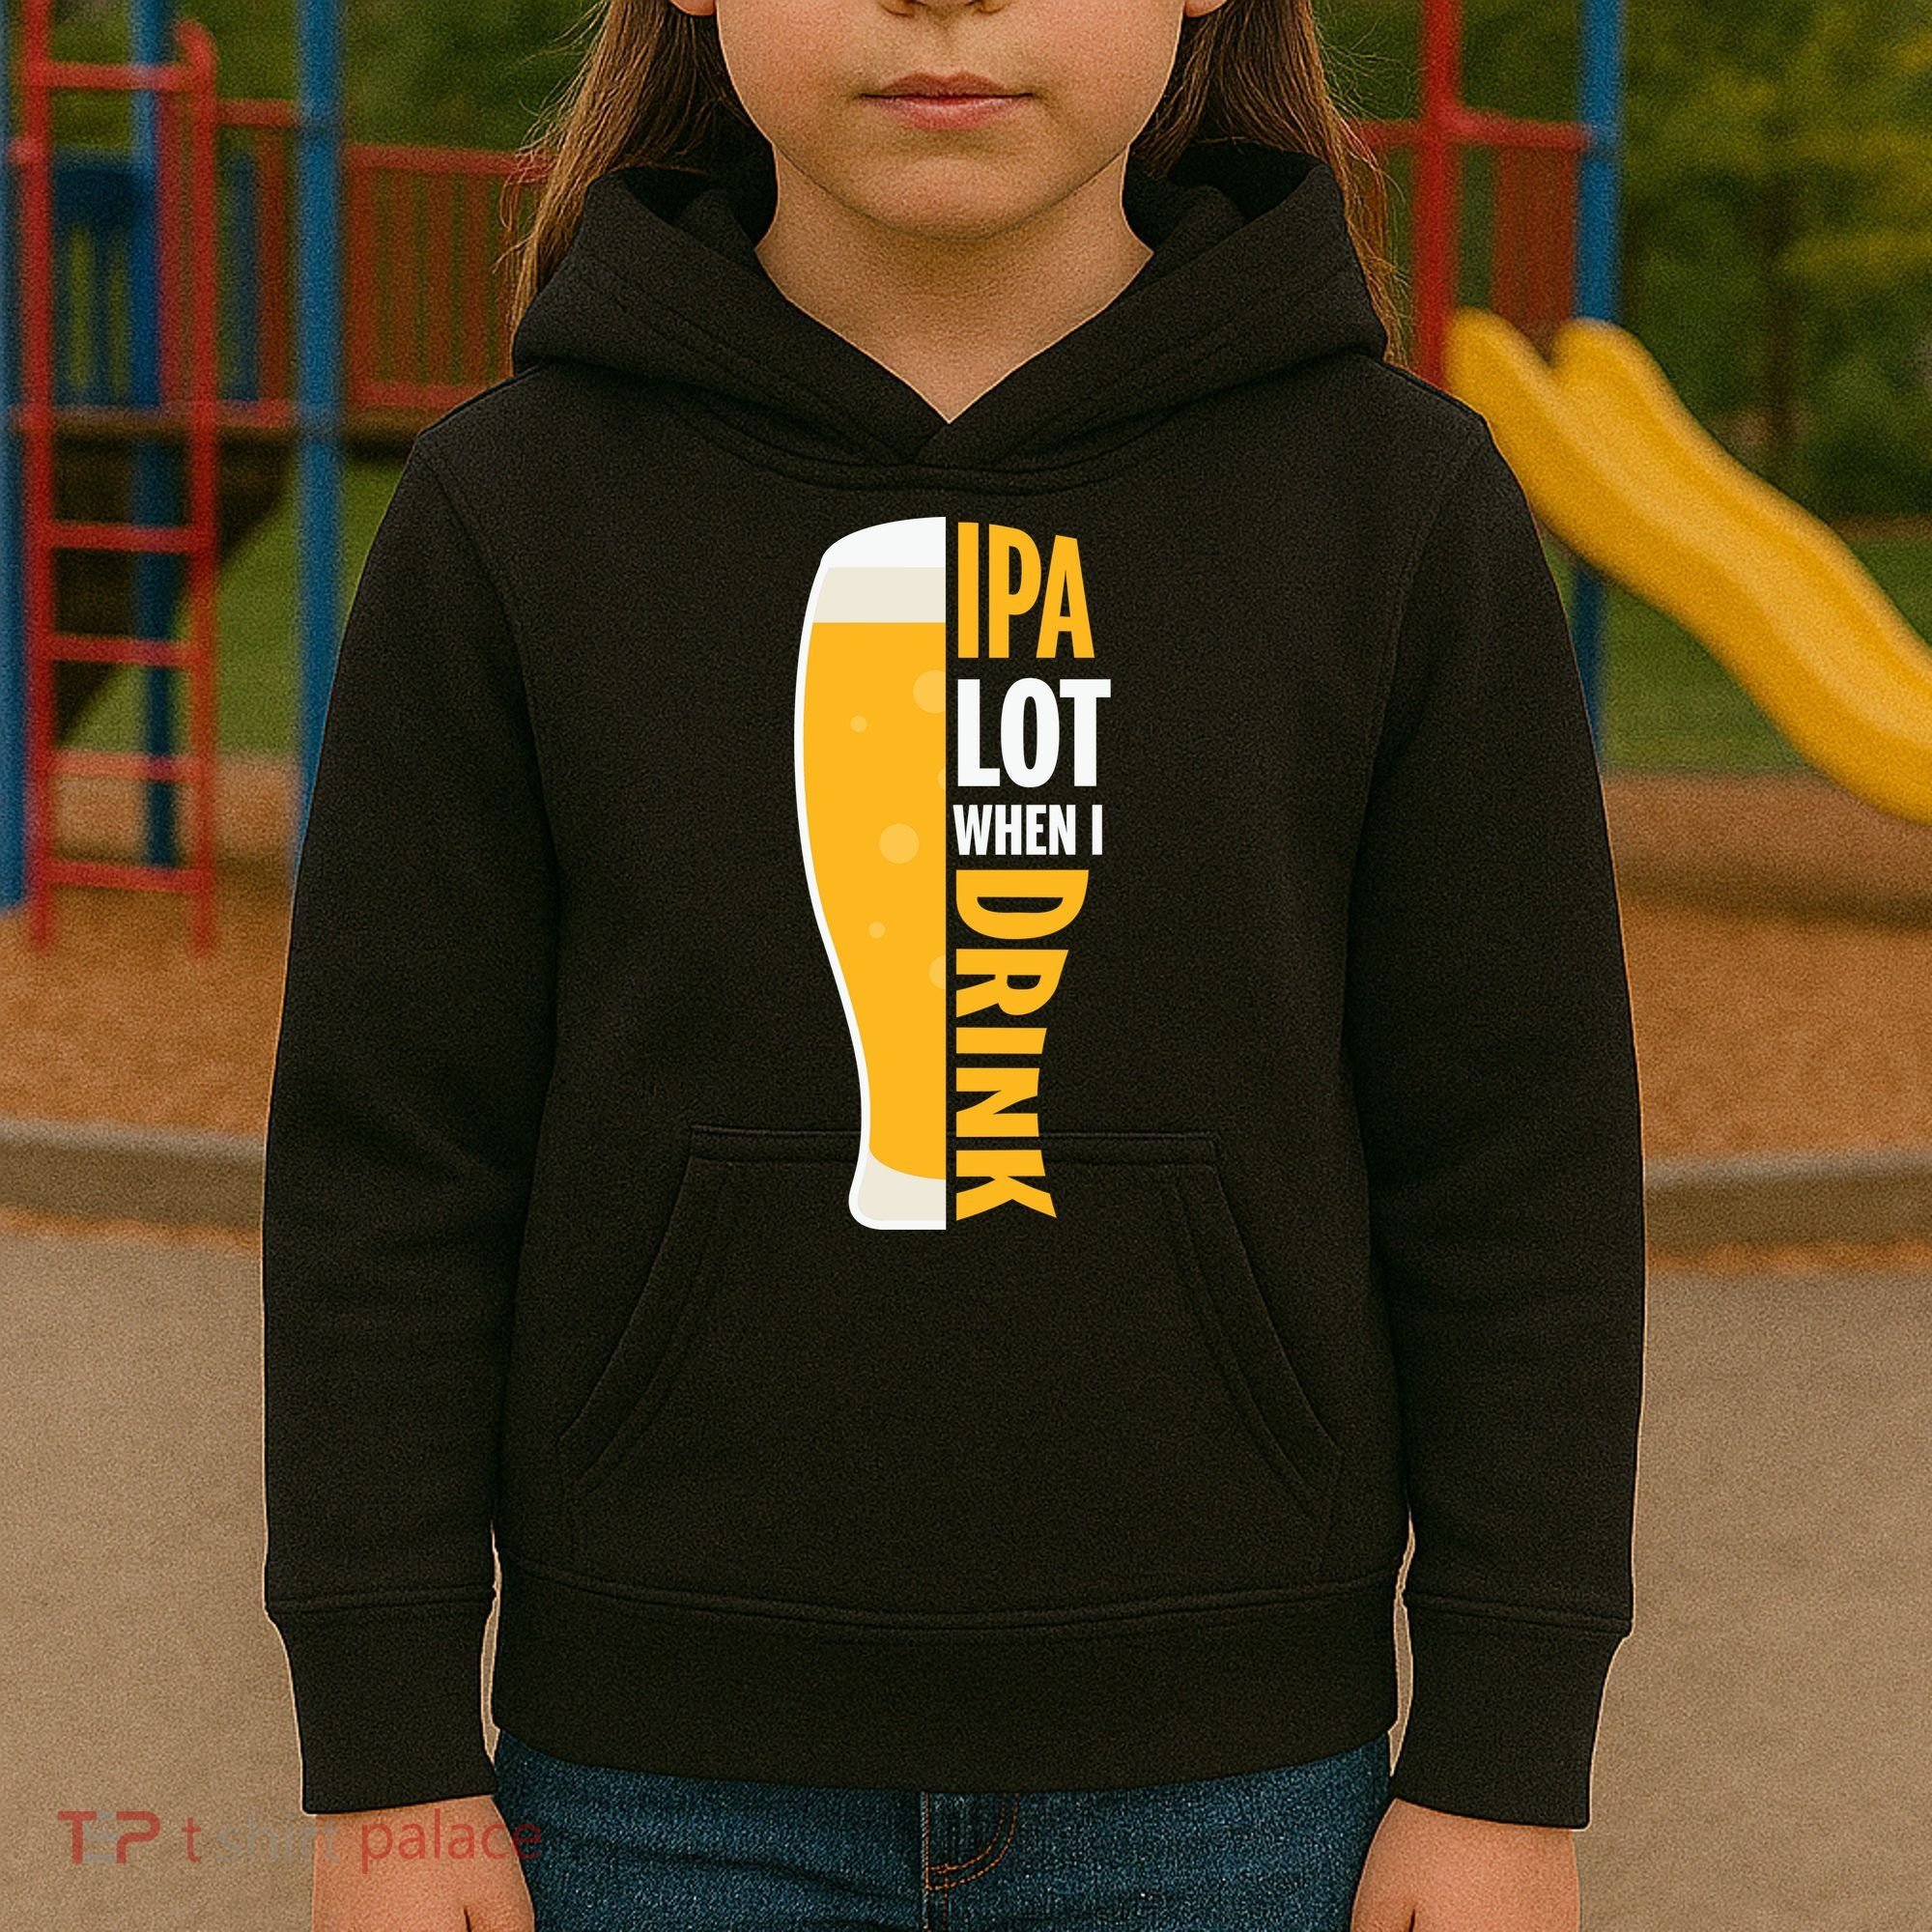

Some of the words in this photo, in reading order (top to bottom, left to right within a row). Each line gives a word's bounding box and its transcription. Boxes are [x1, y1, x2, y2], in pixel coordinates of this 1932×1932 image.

[957, 522, 1095, 659] IPA
[957, 677, 1112, 788] LOT
[952, 804, 1076, 855] WHEN
[1092, 804, 1103, 855] I
[955, 868, 1090, 1222] DRINK
